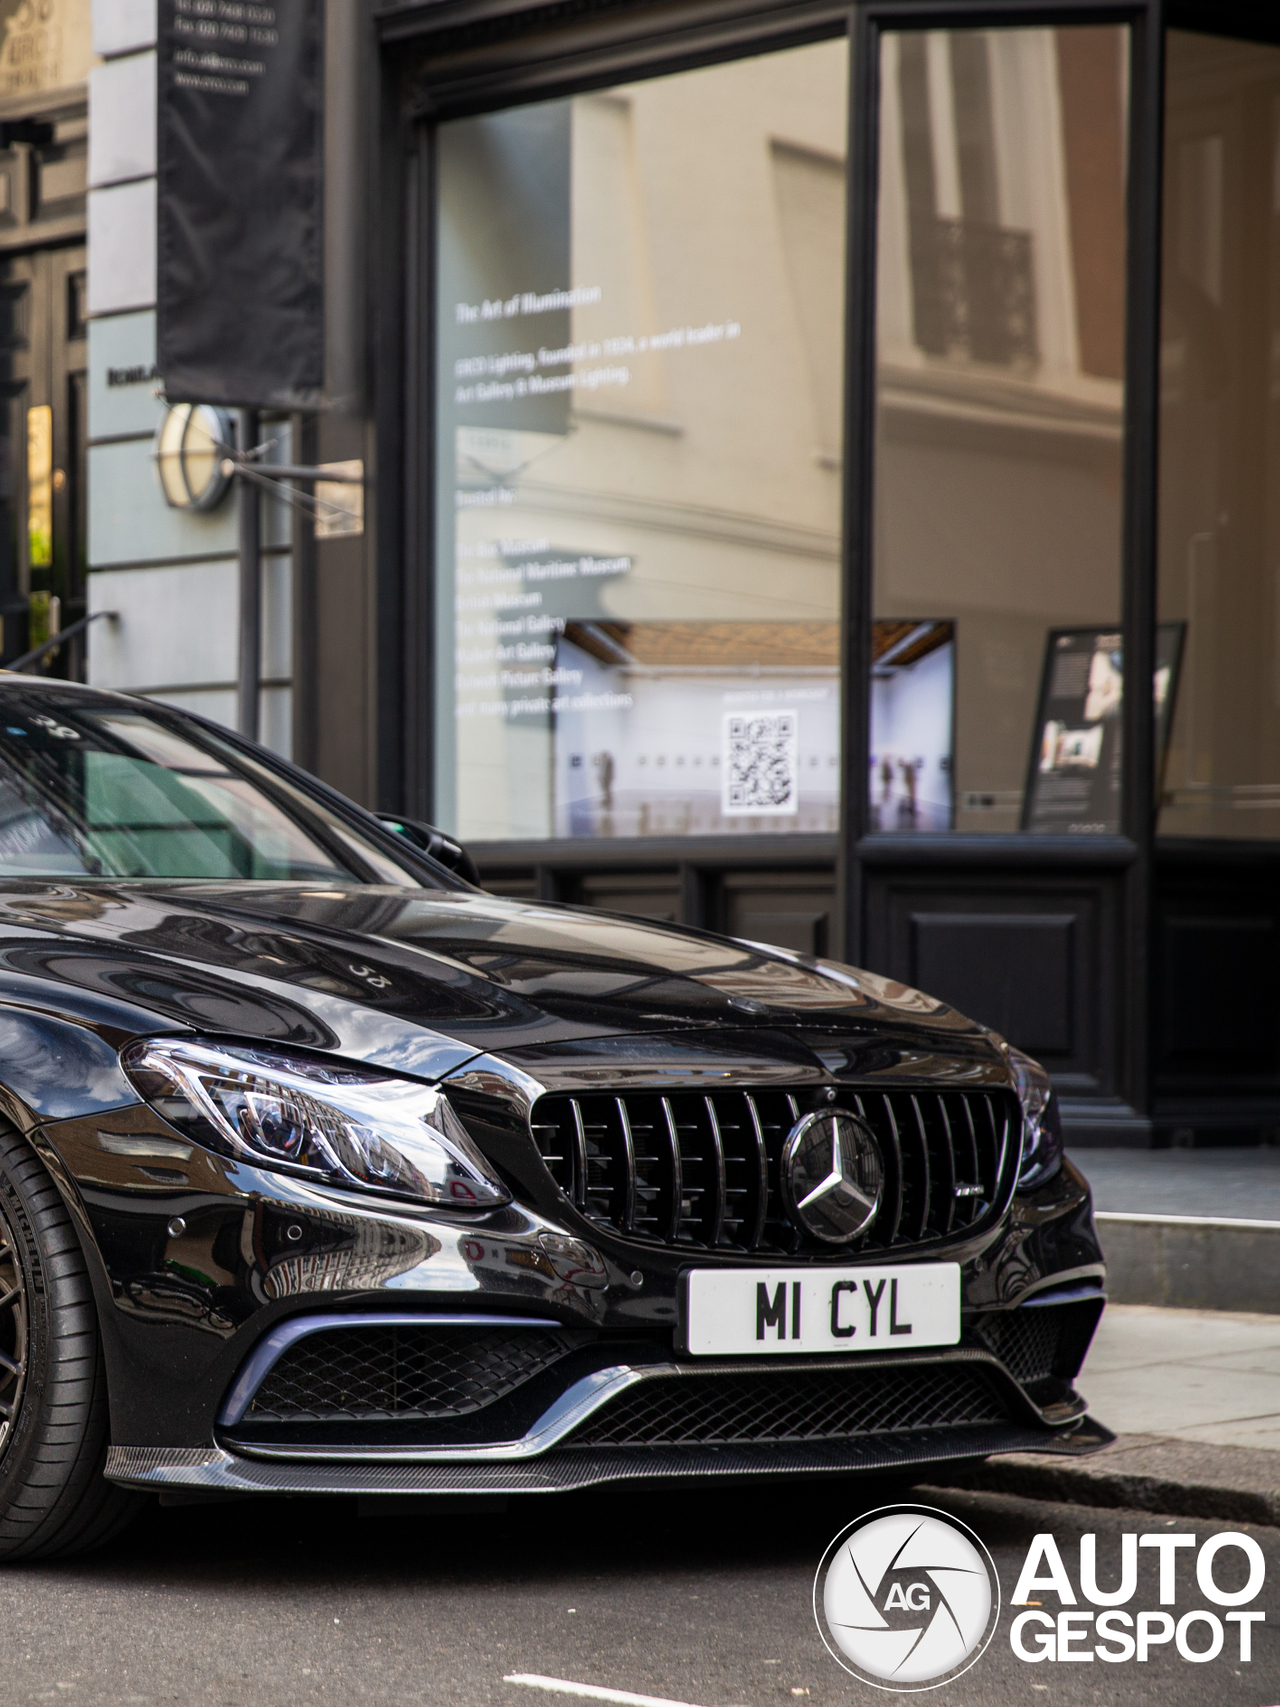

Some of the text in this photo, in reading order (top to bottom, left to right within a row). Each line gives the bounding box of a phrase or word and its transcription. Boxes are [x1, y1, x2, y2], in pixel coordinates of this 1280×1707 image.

[455, 284, 601, 324] The Art of Illumination
[455, 356, 486, 379] ERCO
[537, 345, 587, 368] founded
[588, 339, 601, 359] in
[649, 327, 685, 350] world
[686, 321, 724, 346] leader
[725, 318, 741, 340] in
[455, 385, 474, 404] Art
[475, 381, 513, 404] Gallery
[515, 377, 527, 398] &
[528, 374, 577, 395] Museum
[500, 538, 549, 557] Museum
[478, 564, 525, 583] National
[526, 560, 578, 580] Maritime
[579, 556, 631, 576] Museum
[493, 591, 542, 609] Museum
[478, 617, 524, 634] National
[526, 614, 567, 635] Gallery
[497, 644, 515, 661] Art
[516, 642, 557, 661] Gallery
[500, 669, 539, 687] Picture
[541, 667, 582, 688] Gallery
[508, 695, 550, 718] private
[552, 694, 573, 712] art
[574, 691, 632, 711] collections
[831, 1278, 912, 1338] CYL
